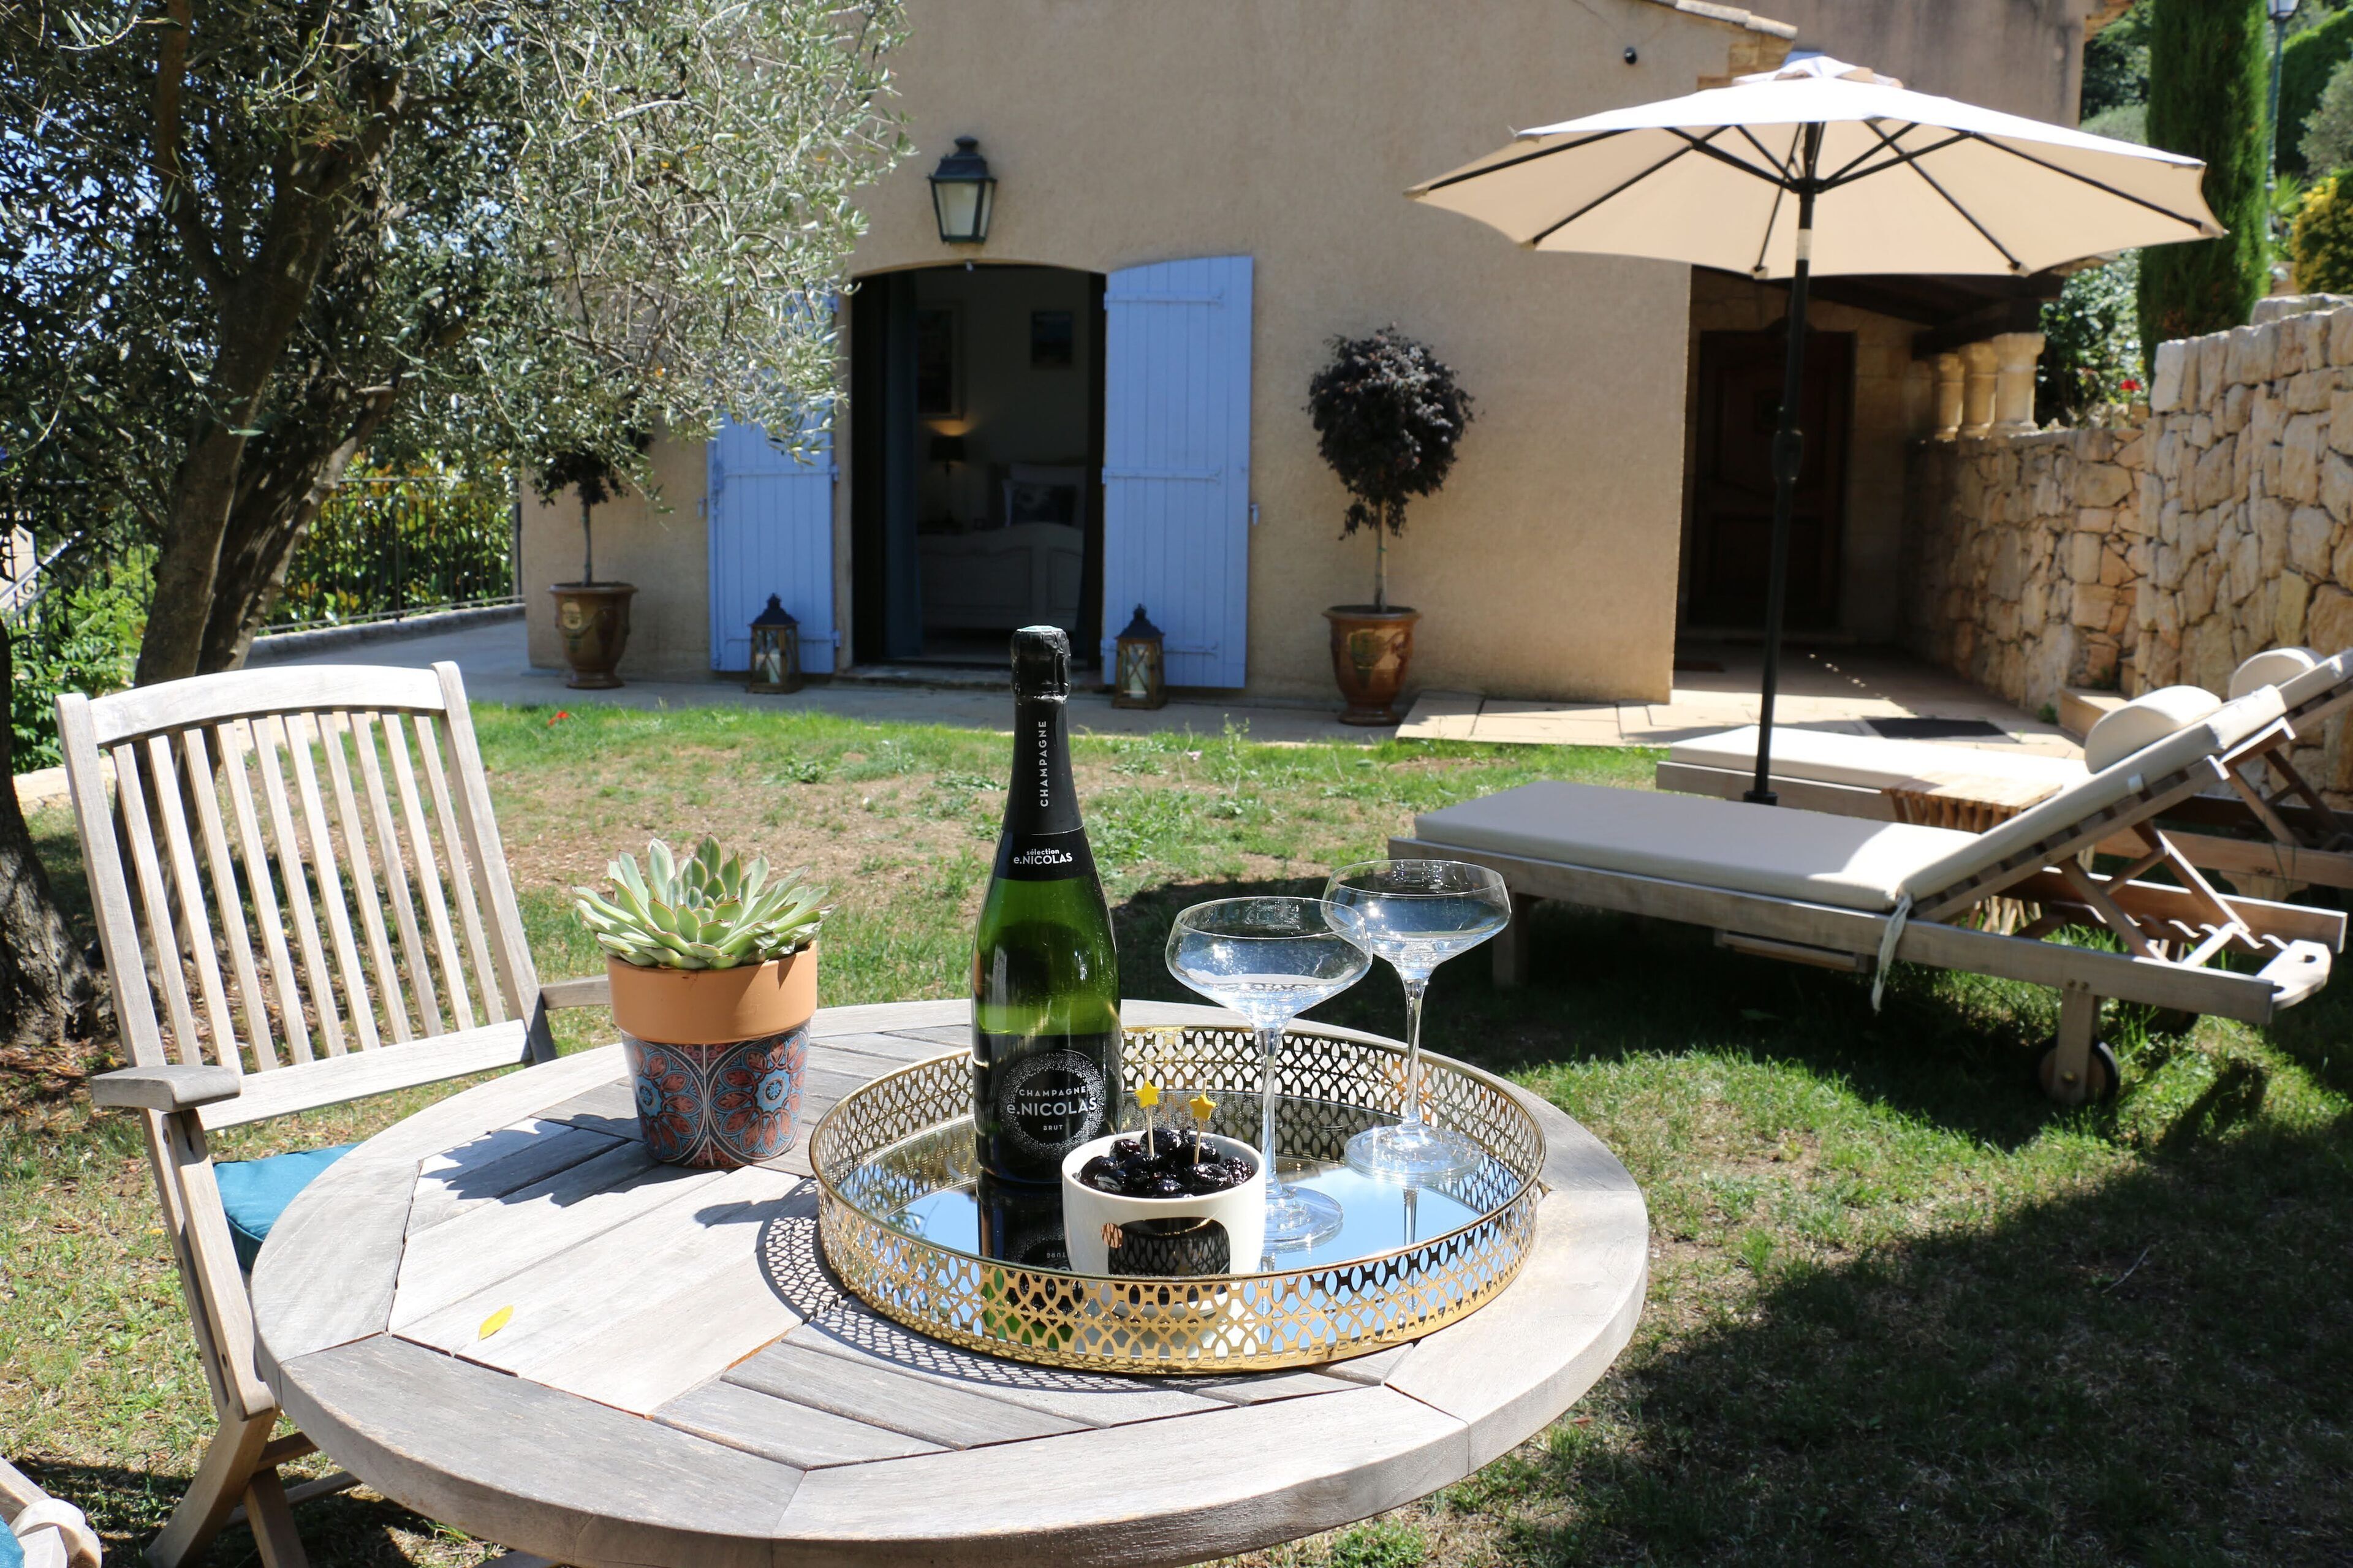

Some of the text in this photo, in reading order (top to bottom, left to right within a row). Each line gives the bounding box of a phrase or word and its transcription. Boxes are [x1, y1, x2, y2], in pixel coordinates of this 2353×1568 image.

[1038, 721, 1048, 807] CHAMPAGNE
[1014, 852, 1073, 865] e.NICOLAS
[1019, 1086, 1086, 1096] CHAMPAGNE
[1007, 1097, 1097, 1116] e.NICOLAS
